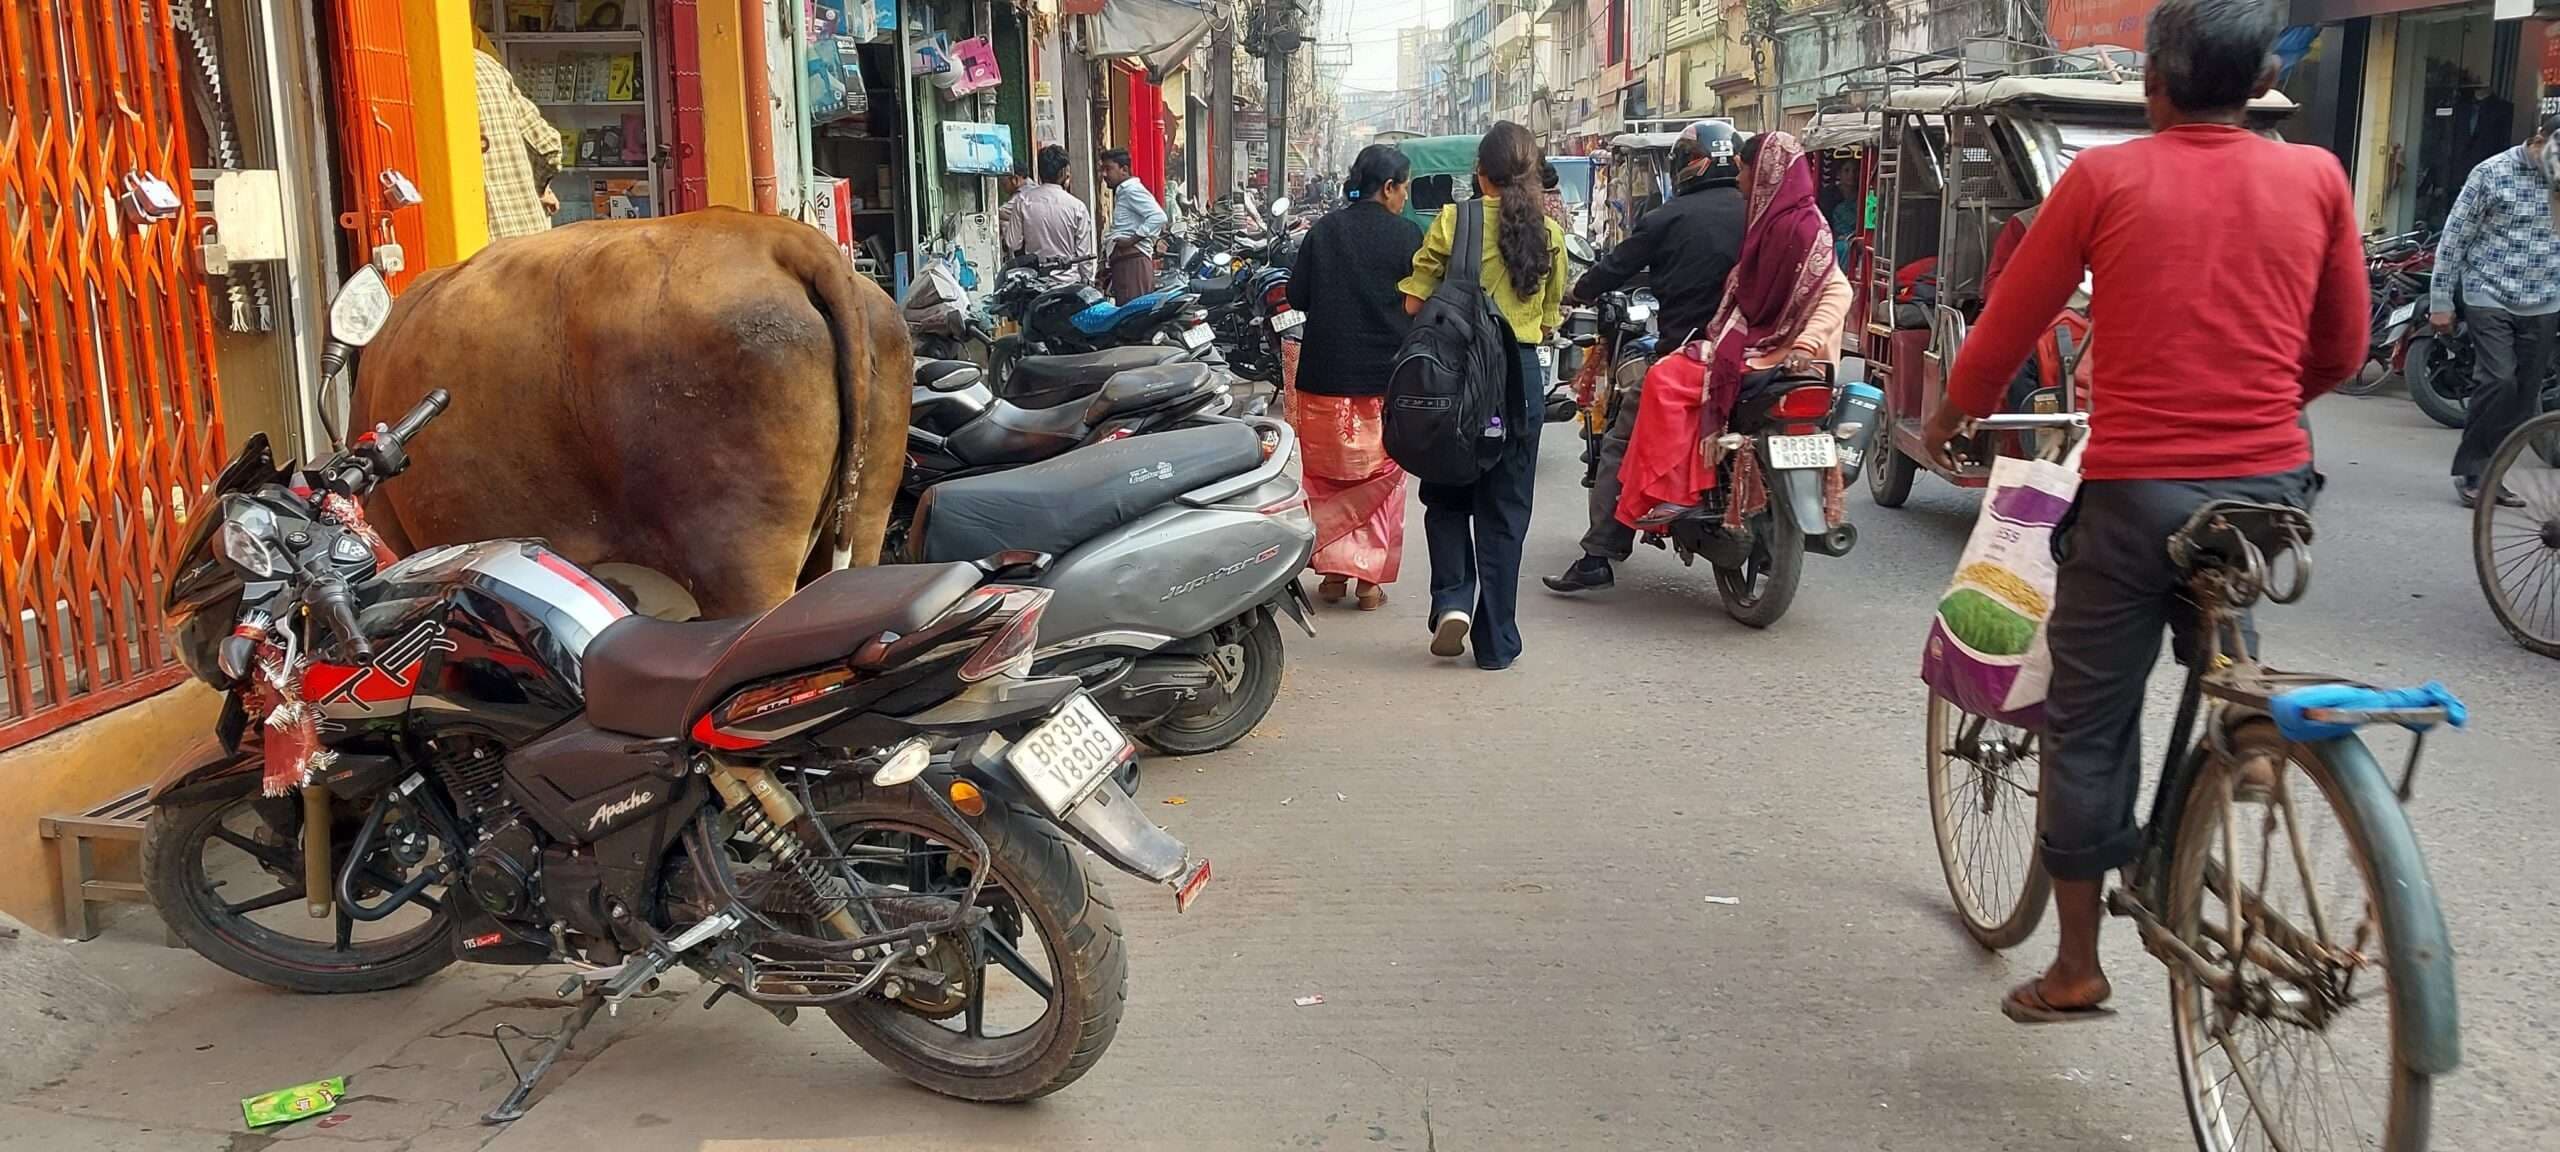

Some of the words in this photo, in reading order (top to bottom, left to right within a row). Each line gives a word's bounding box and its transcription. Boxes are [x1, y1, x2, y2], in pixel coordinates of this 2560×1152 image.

[1029, 706, 1093, 766] BR39A
[1048, 729, 1112, 788] V8909
[587, 787, 656, 832] Apache
